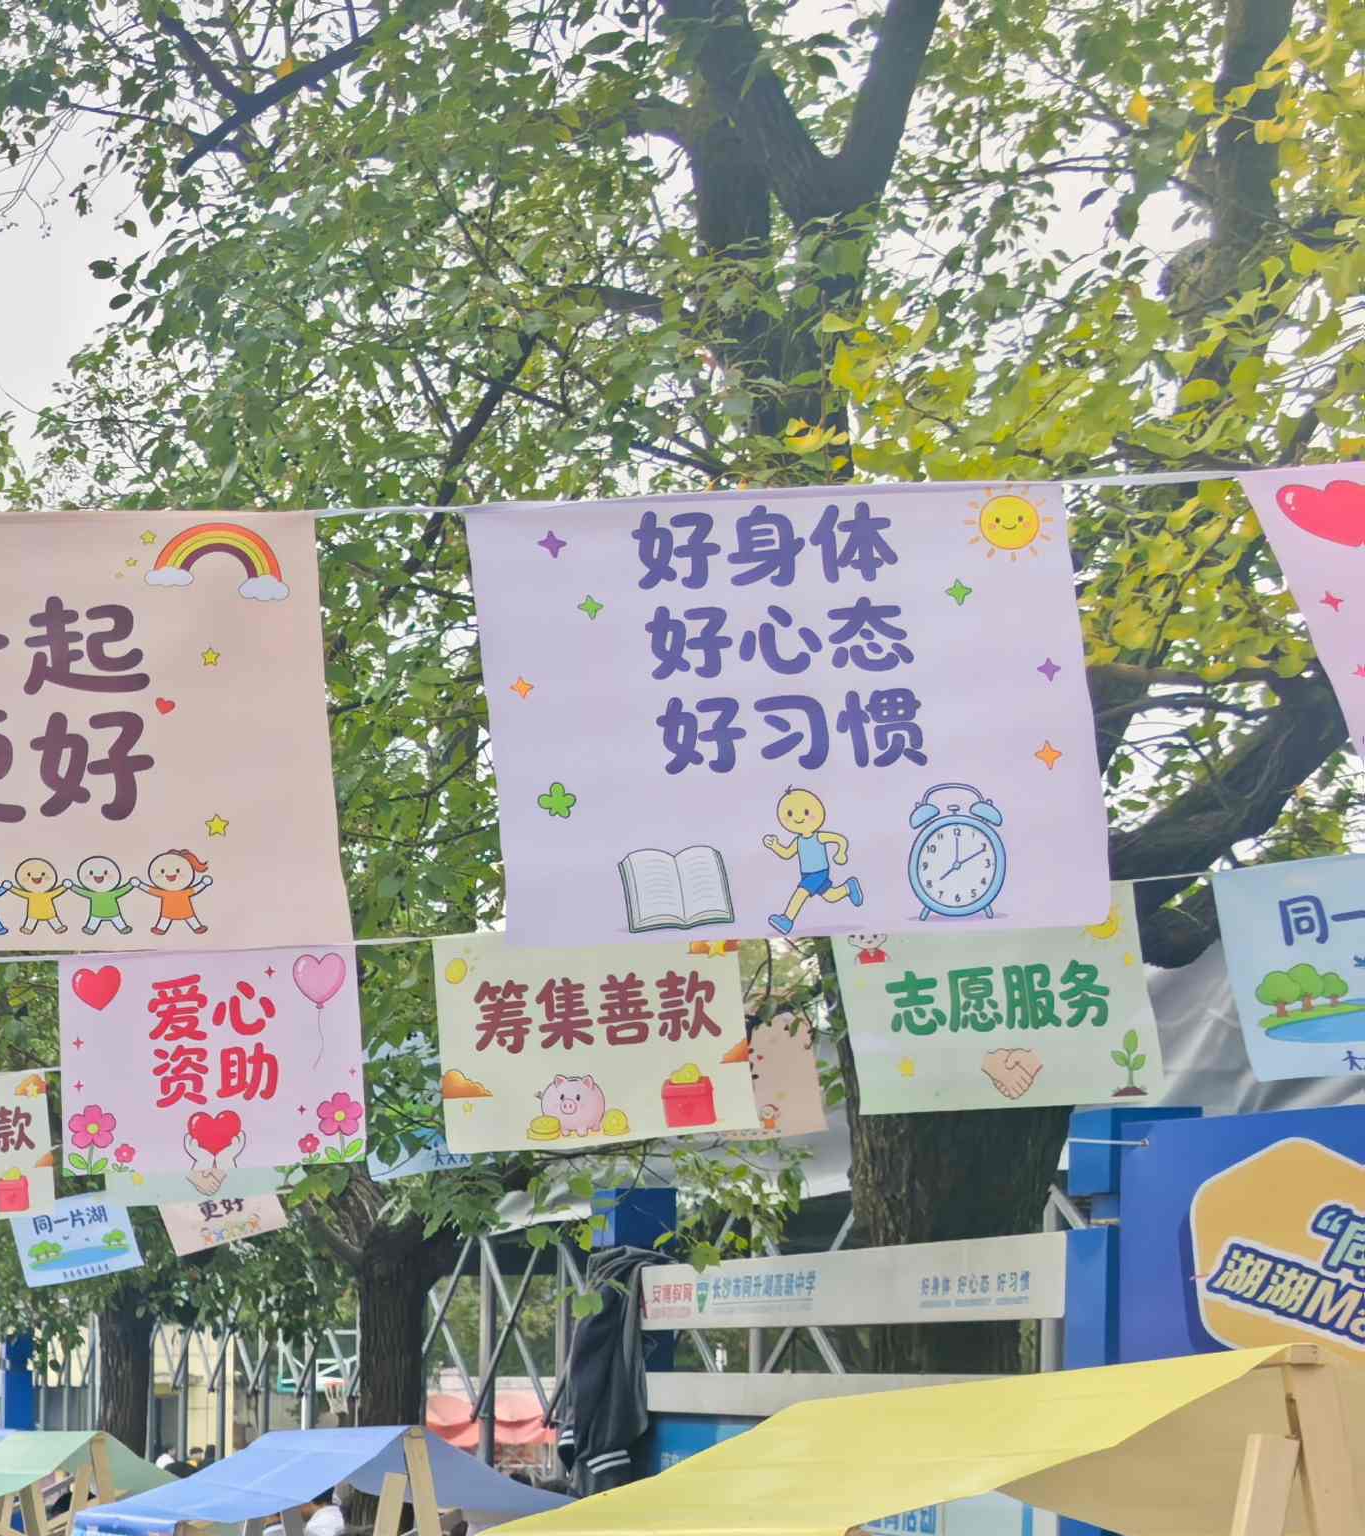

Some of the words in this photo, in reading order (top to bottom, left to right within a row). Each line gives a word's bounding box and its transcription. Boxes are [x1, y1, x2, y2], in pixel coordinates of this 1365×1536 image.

[631, 503, 898, 590] 好身体
[644, 596, 915, 681] 好心态
[655, 687, 929, 775] 好习惯
[147, 973, 277, 1043] 爱心
[473, 970, 723, 1055] 筹集善款
[886, 958, 1111, 1039] 志愿服务
[152, 1042, 280, 1109] 资助
[32, 1203, 109, 1237] 同一片湖
[198, 1198, 246, 1223] 更好
